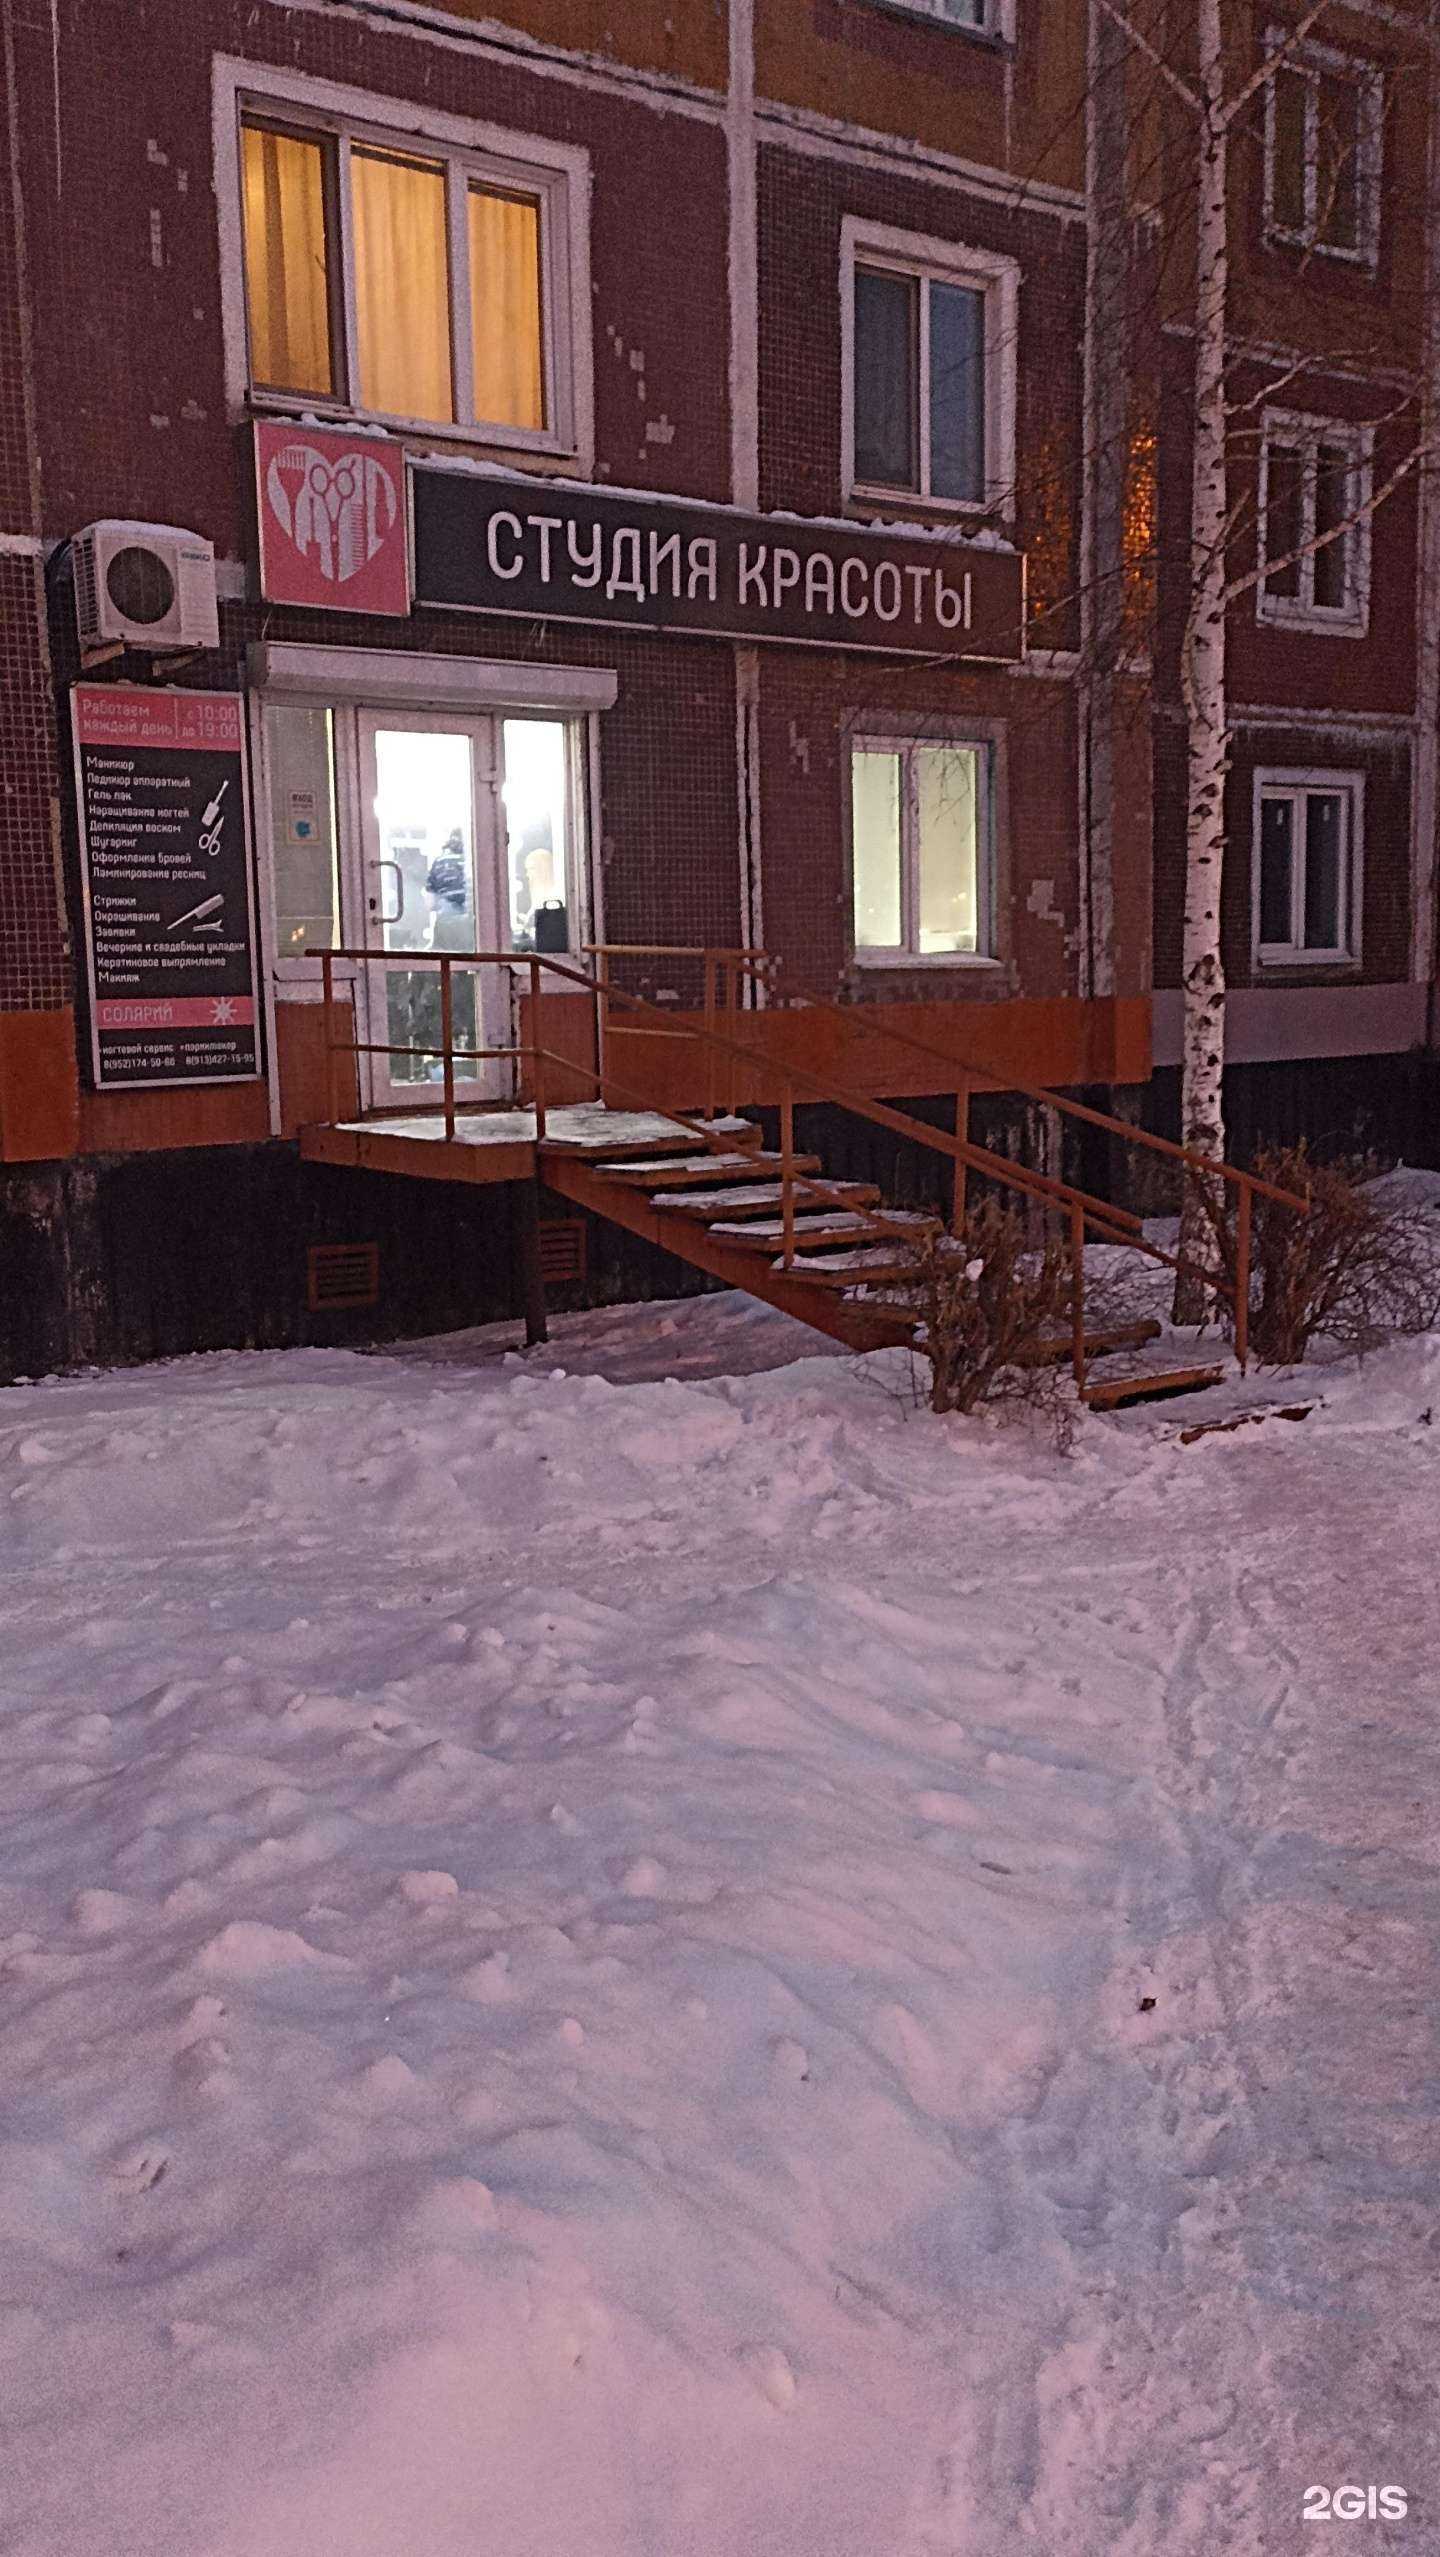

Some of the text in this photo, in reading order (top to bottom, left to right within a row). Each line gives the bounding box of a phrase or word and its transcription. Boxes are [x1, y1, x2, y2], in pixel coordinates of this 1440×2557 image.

[487, 511, 973, 630] СТУДИЯ КРАСОТЫ
[83, 699, 150, 717] Работаем
[196, 704, 238, 721] 10:00
[83, 720, 172, 736] каждый день
[196, 722, 238, 738] 19:00
[86, 756, 135, 771] Маникюр
[87, 773, 191, 789] Педикюр аппаратный
[88, 788, 132, 800] Гель лак
[89, 805, 190, 817] Наращивание ногтей
[90, 820, 181, 832] Депиляция воском
[91, 836, 137, 848] Шугаринг
[92, 851, 192, 865] Оформление бровей
[171, 870, 207, 880] ресниц
[94, 895, 137, 907] Стрижки
[95, 910, 161, 922] Окрашивание
[96, 927, 136, 937] Завивки
[97, 941, 143, 954] Вечерние
[153, 940, 205, 952] свадебные
[206, 943, 245, 954] укладки
[98, 957, 226, 969] Кератиновое выпрямление
[99, 971, 141, 982] Макияж
[103, 1003, 173, 1022] СОЛЯРИЙ
